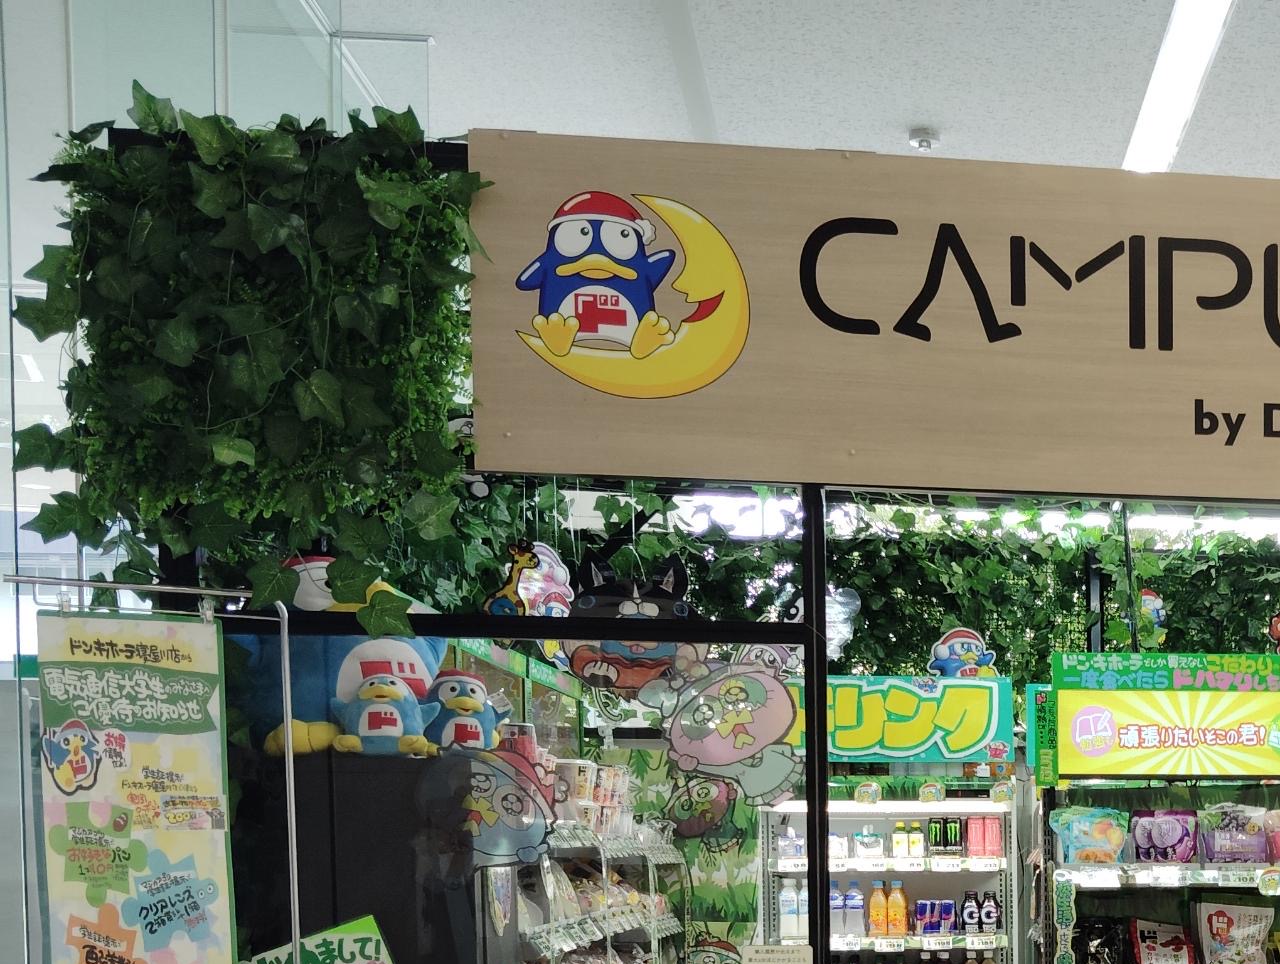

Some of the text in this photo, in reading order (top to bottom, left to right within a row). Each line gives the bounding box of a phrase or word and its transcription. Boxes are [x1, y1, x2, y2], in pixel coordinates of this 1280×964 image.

[1193, 400, 1247, 447] by
[1119, 722, 1266, 749] 頑張りたいそこの君!
[139, 886, 195, 920] クリアレンズ
